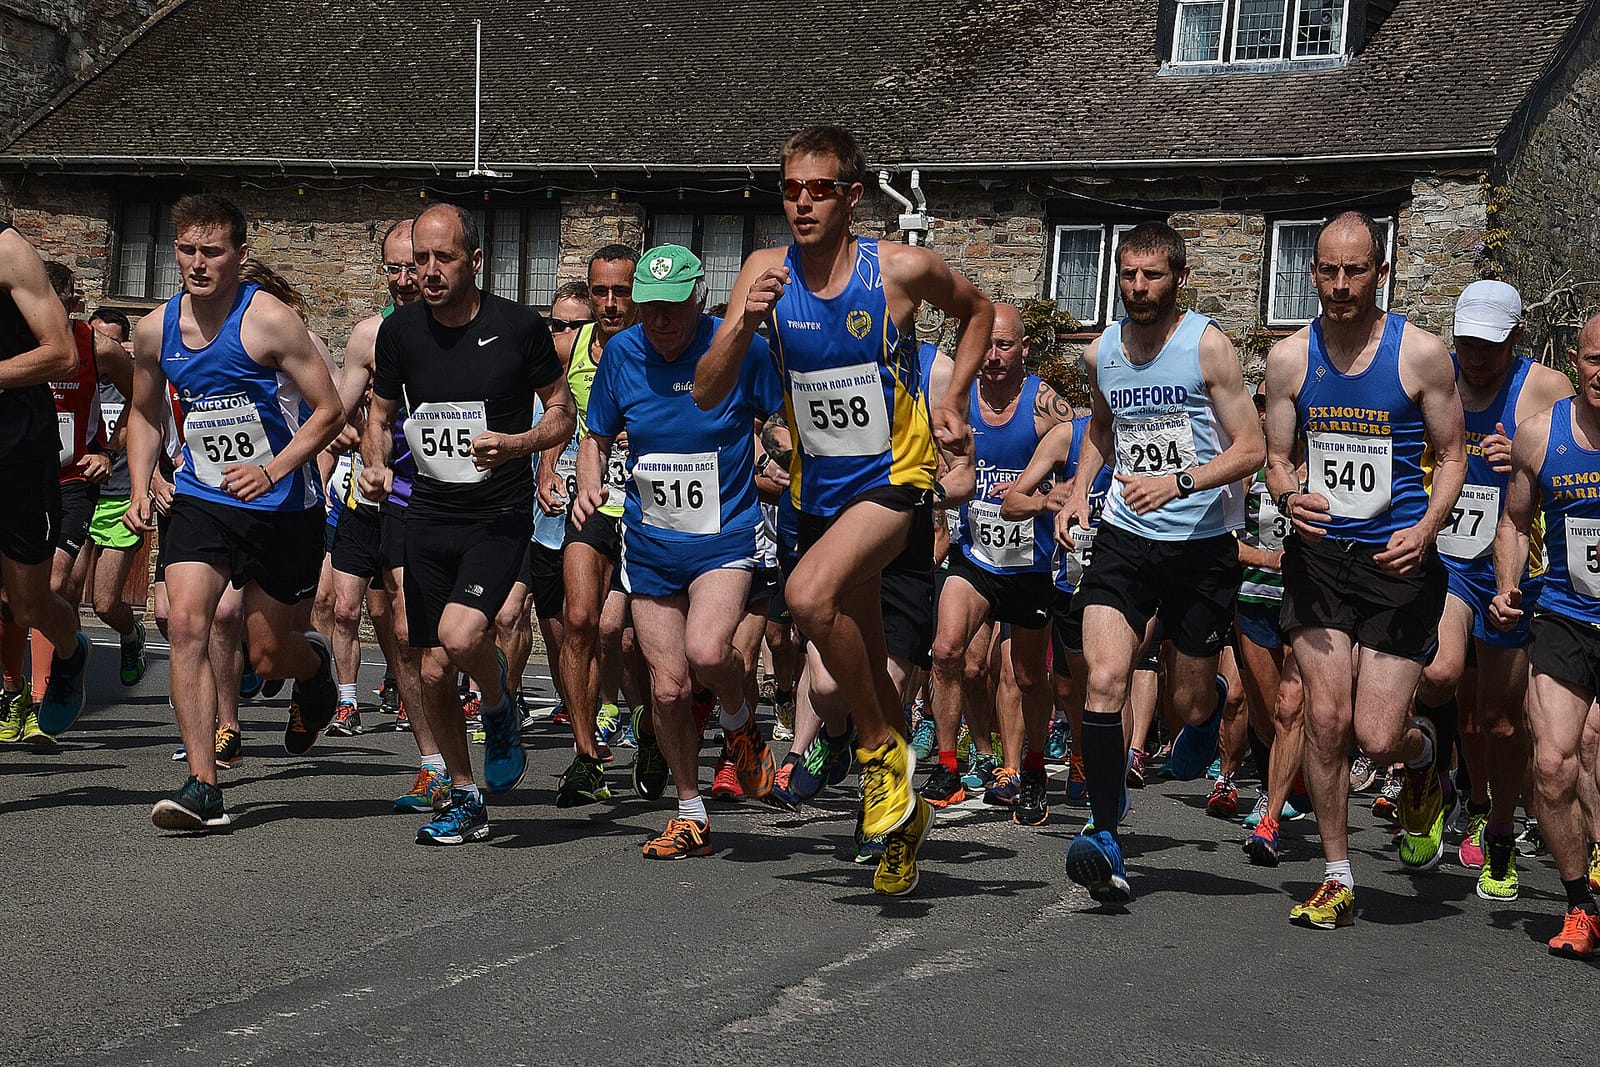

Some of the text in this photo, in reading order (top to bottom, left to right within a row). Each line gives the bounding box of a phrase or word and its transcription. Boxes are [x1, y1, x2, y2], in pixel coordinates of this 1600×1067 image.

[787, 319, 821, 331] TRIMTEX
[793, 374, 877, 392] TIVERTON ROAD RACE
[1110, 386, 1188, 409] BIDEFORD
[441, 411, 461, 420] ROAD
[462, 411, 482, 420] RACE
[808, 396, 870, 430] 558
[1309, 406, 1390, 422] EXMOUTH
[187, 414, 256, 430] TIVERTON ROAD RACE
[1165, 419, 1185, 429] RACE
[1309, 421, 1391, 435] HARRIERS
[202, 432, 255, 463] 528
[421, 428, 472, 458] 545
[1312, 440, 1388, 455] TIVERTON ROAD RACE
[1131, 441, 1183, 473] 294
[637, 462, 715, 472] TIVERTON ROAD RACE
[1323, 460, 1376, 493] 540
[1552, 471, 1600, 487] EXMO
[652, 480, 704, 509] 516
[1476, 493, 1495, 501] RACE
[971, 507, 998, 518] TIVERTON
[980, 523, 1022, 548] 534
